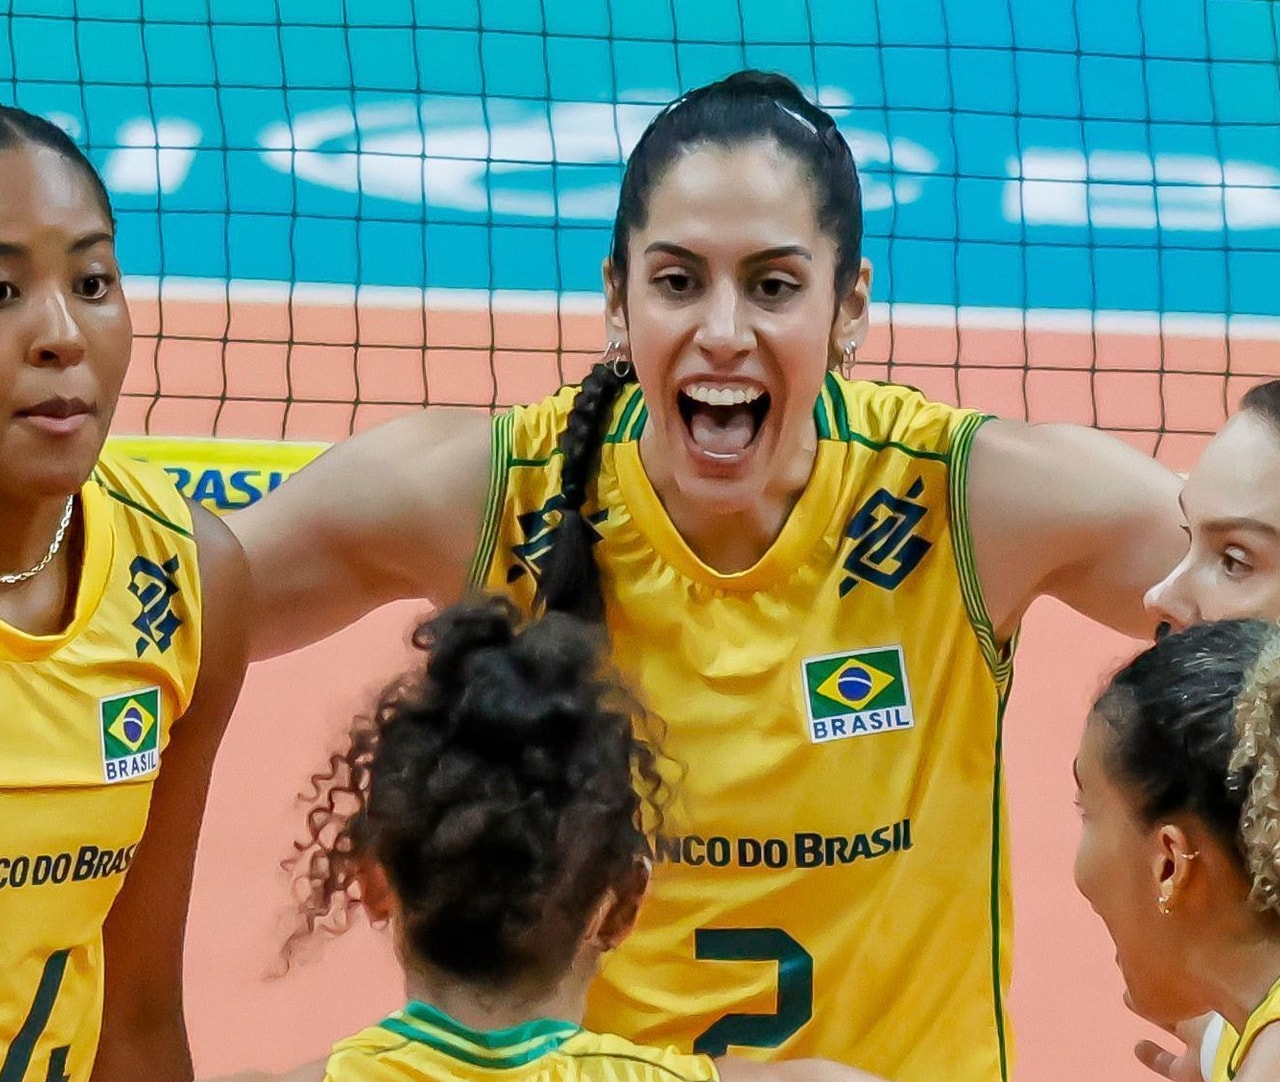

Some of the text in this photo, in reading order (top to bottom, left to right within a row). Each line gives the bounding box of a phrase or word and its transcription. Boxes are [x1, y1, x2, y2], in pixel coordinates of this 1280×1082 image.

[813, 708, 910, 740] BRASIL
[106, 750, 157, 781] BRASIL
[737, 837, 788, 869] DO
[794, 817, 914, 869] BRASIL
[32, 852, 73, 886] DO
[72, 844, 139, 882] BRAS
[693, 927, 814, 1057] 2
